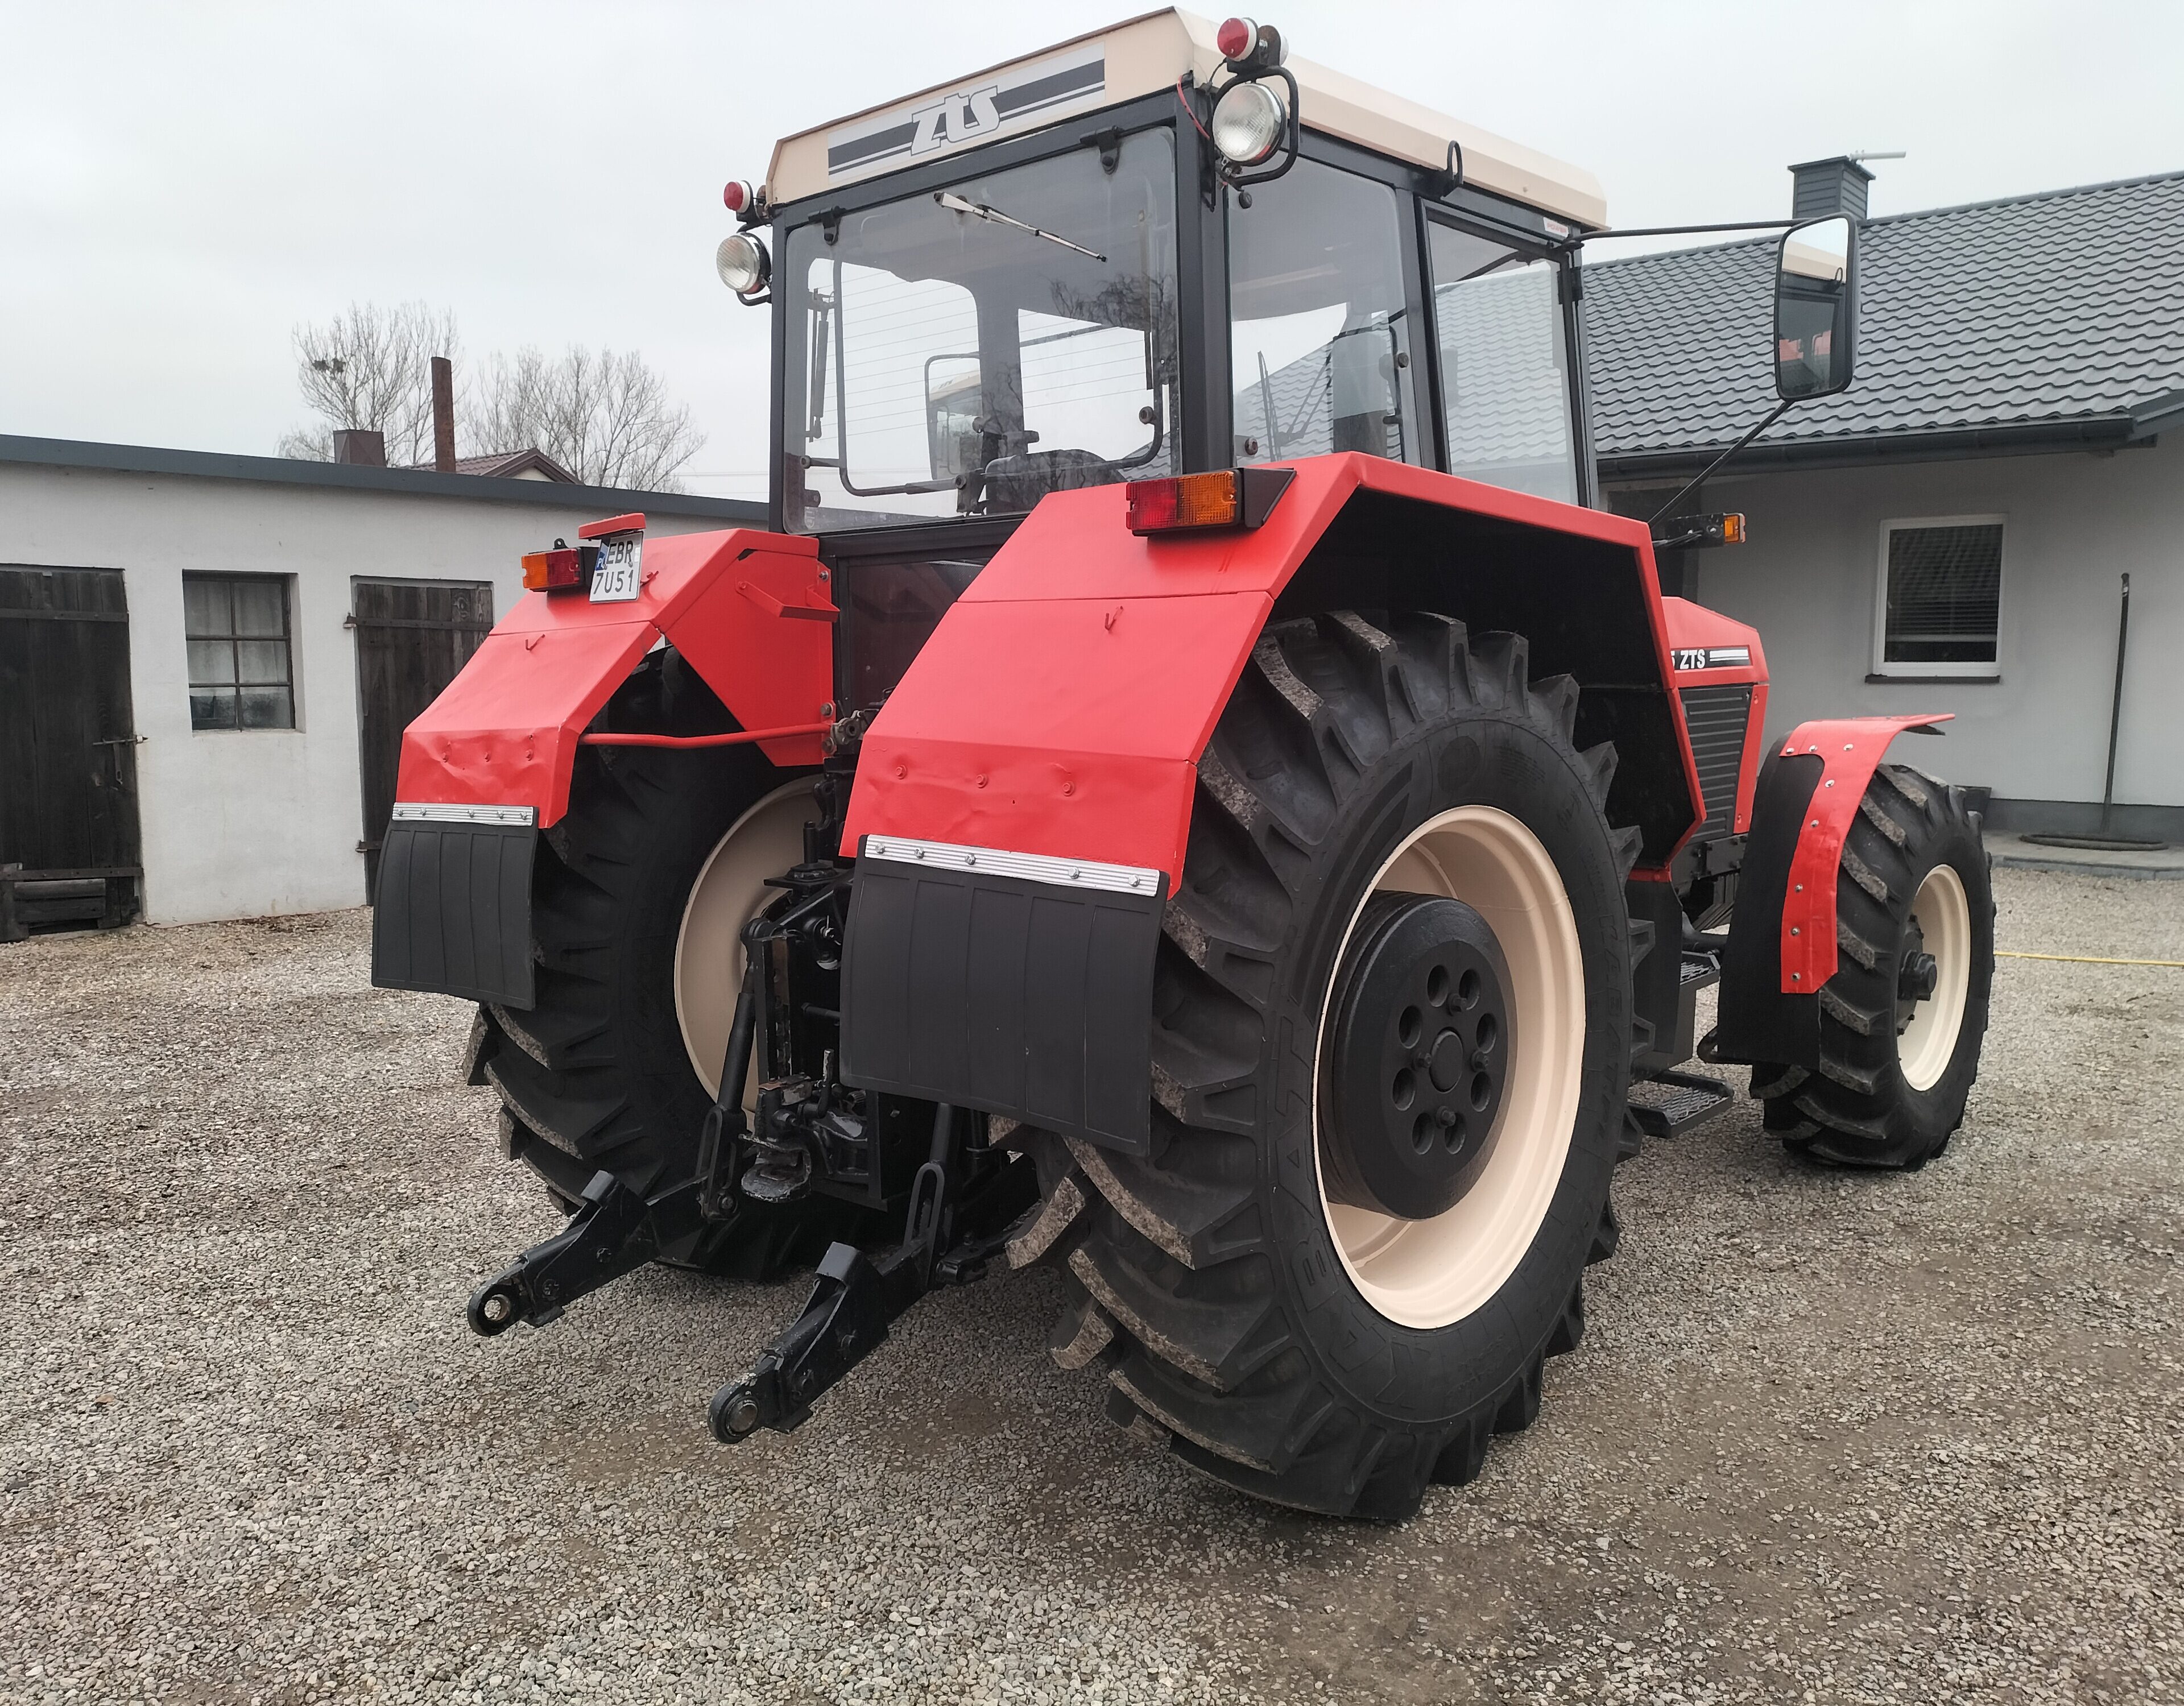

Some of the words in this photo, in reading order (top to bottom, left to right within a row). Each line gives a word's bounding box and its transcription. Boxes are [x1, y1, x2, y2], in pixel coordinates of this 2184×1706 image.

[606, 540, 634, 565] EBR
[593, 569, 634, 595] 7U51
[1680, 648, 1706, 669] ZTS
